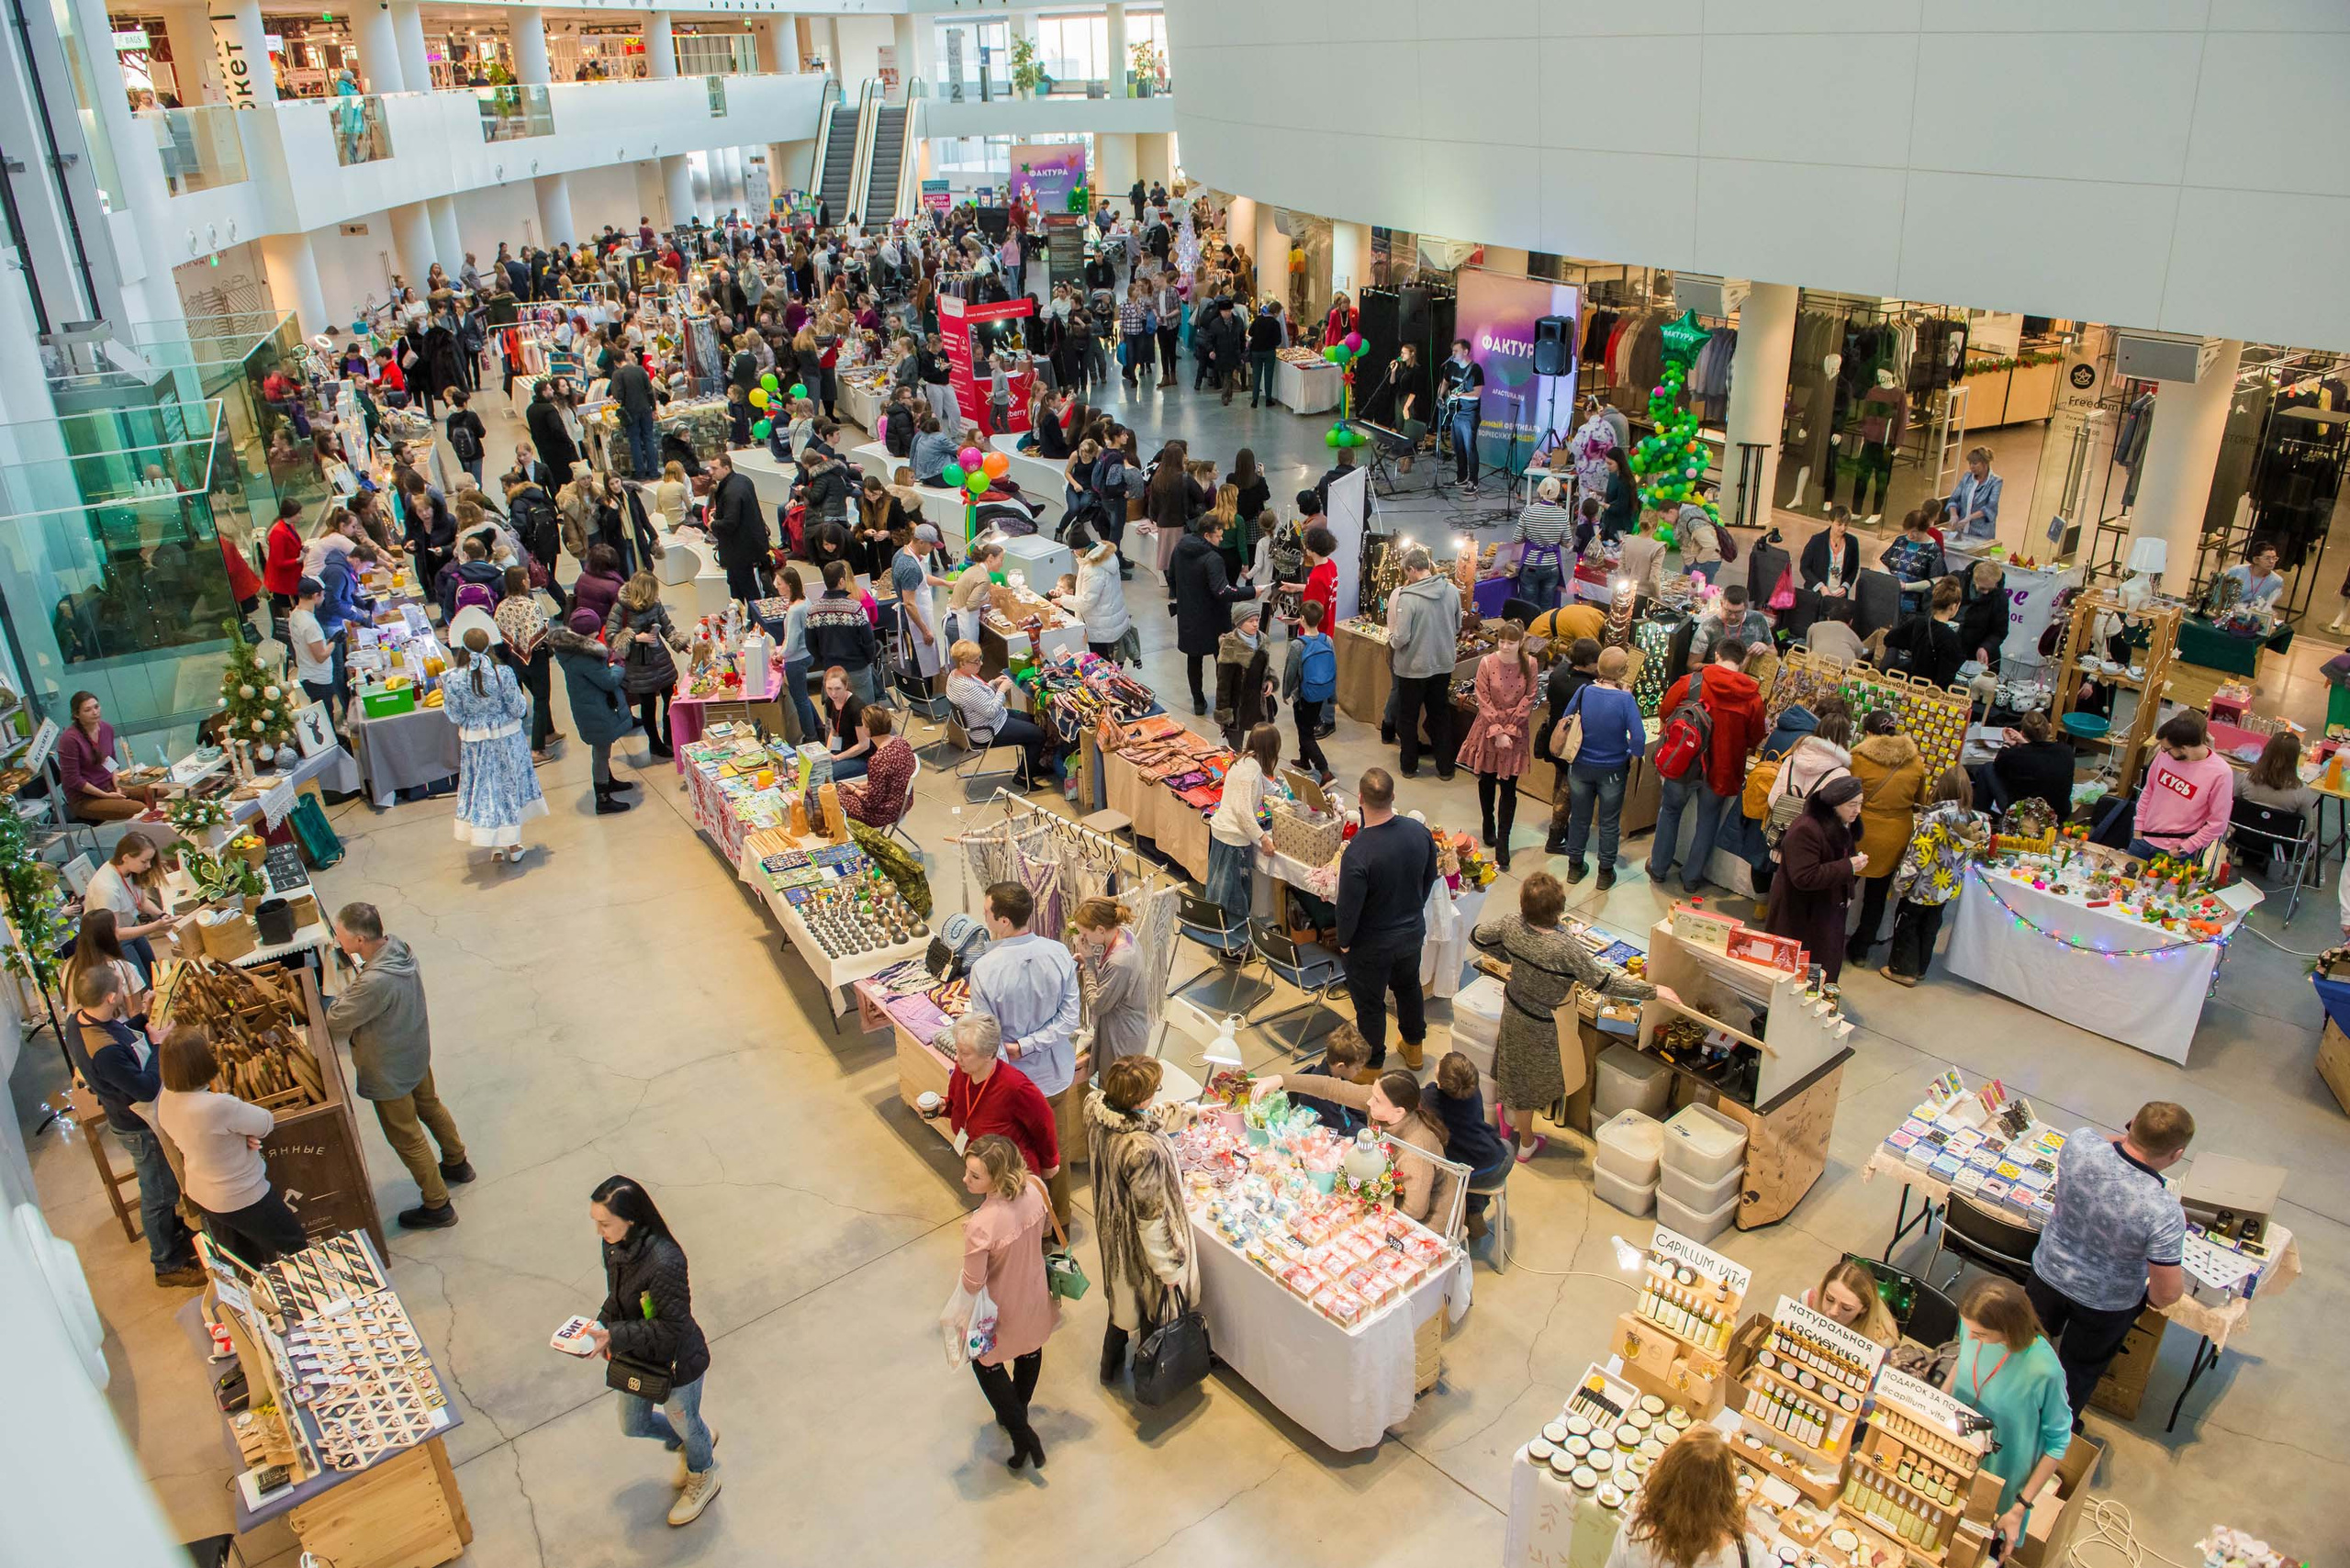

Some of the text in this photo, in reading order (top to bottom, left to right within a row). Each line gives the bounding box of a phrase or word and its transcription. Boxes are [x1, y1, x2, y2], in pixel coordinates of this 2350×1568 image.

[1029, 168, 1069, 177] ФАКТУРА
[1663, 330, 1694, 342] ФАКТУРА
[1482, 335, 1534, 359] ФАКТУР
[2069, 396, 2118, 412] Freedom
[1478, 429, 1512, 440] ВОРЧЕСКИХ
[1848, 668, 1864, 679] Ваш
[1907, 685, 1925, 696] Ваш
[2159, 772, 2191, 796] КУСЬ
[1656, 1233, 1747, 1288] CAPILLUM VITA
[557, 1319, 583, 1339] БИГ
[1789, 1303, 1874, 1352] натуральная
[1790, 1320, 1861, 1365] косметика
[1885, 1371, 1929, 1395] ПОДАРОК
[1930, 1392, 1941, 1404] ЗА
